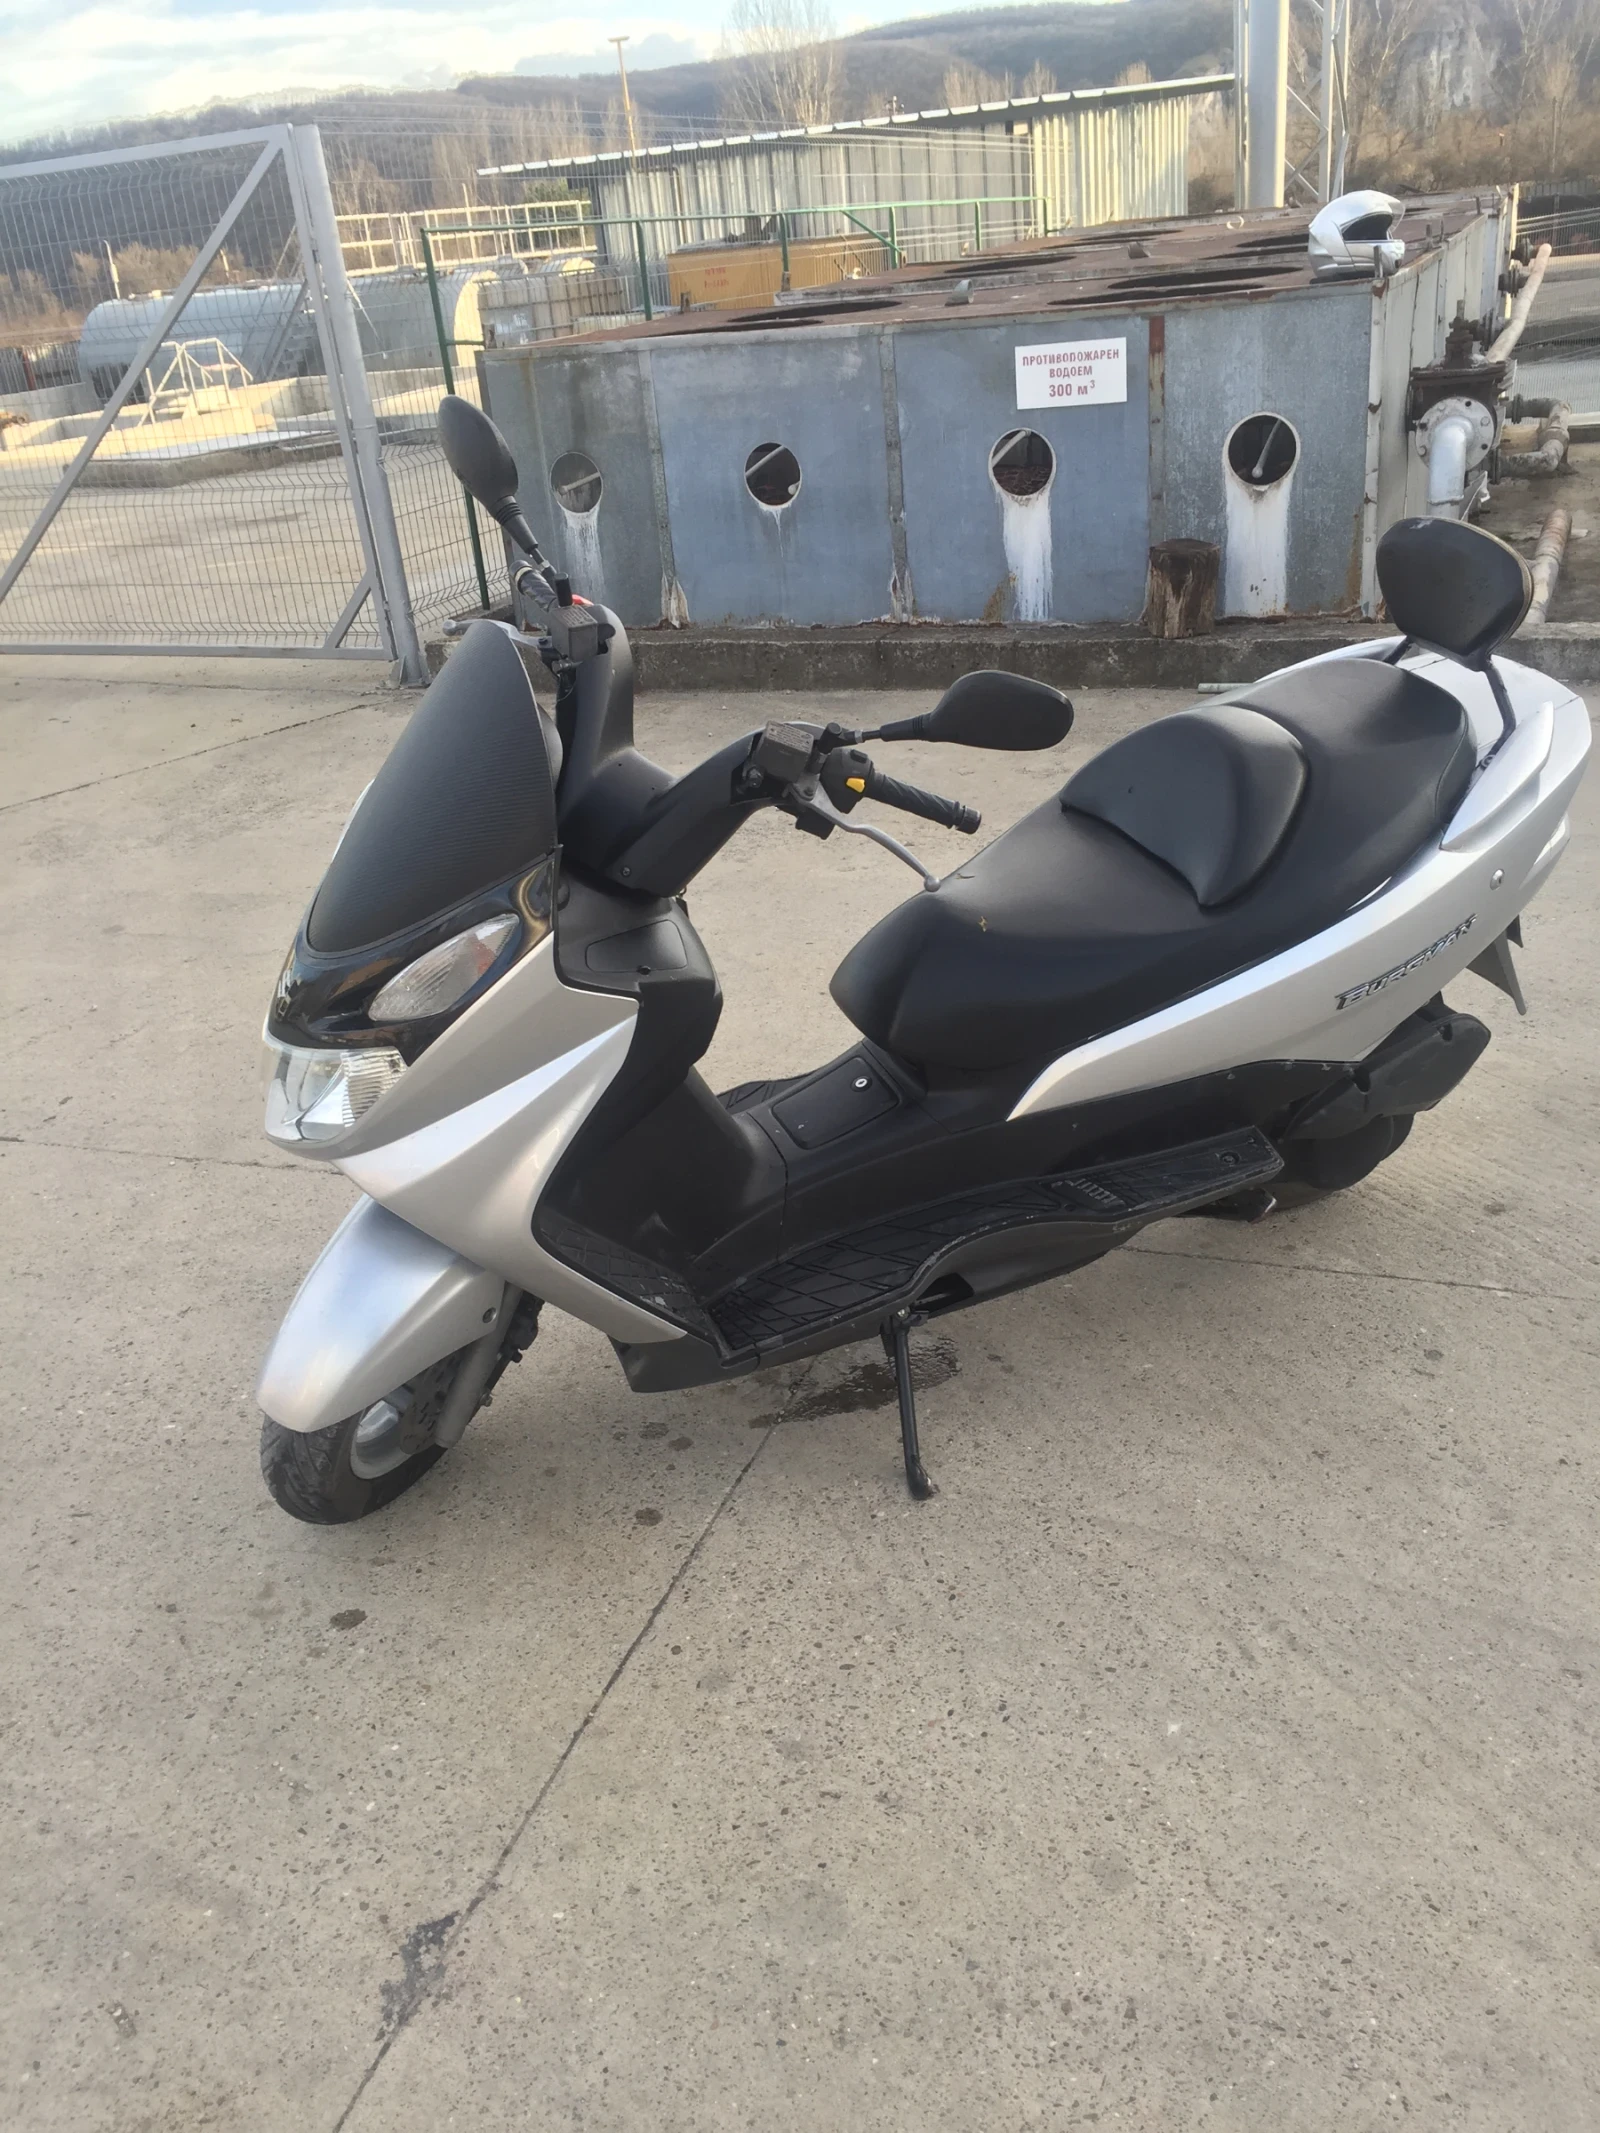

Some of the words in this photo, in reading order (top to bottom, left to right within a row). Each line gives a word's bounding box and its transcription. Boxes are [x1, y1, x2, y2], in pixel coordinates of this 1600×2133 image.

[1022, 349, 1119, 366] ПРОТИВОПОЖАРЕН
[1049, 365, 1092, 378] ВОДОЕМ
[1049, 383, 1072, 397] 300
[1334, 913, 1478, 1010] BURGMAN
